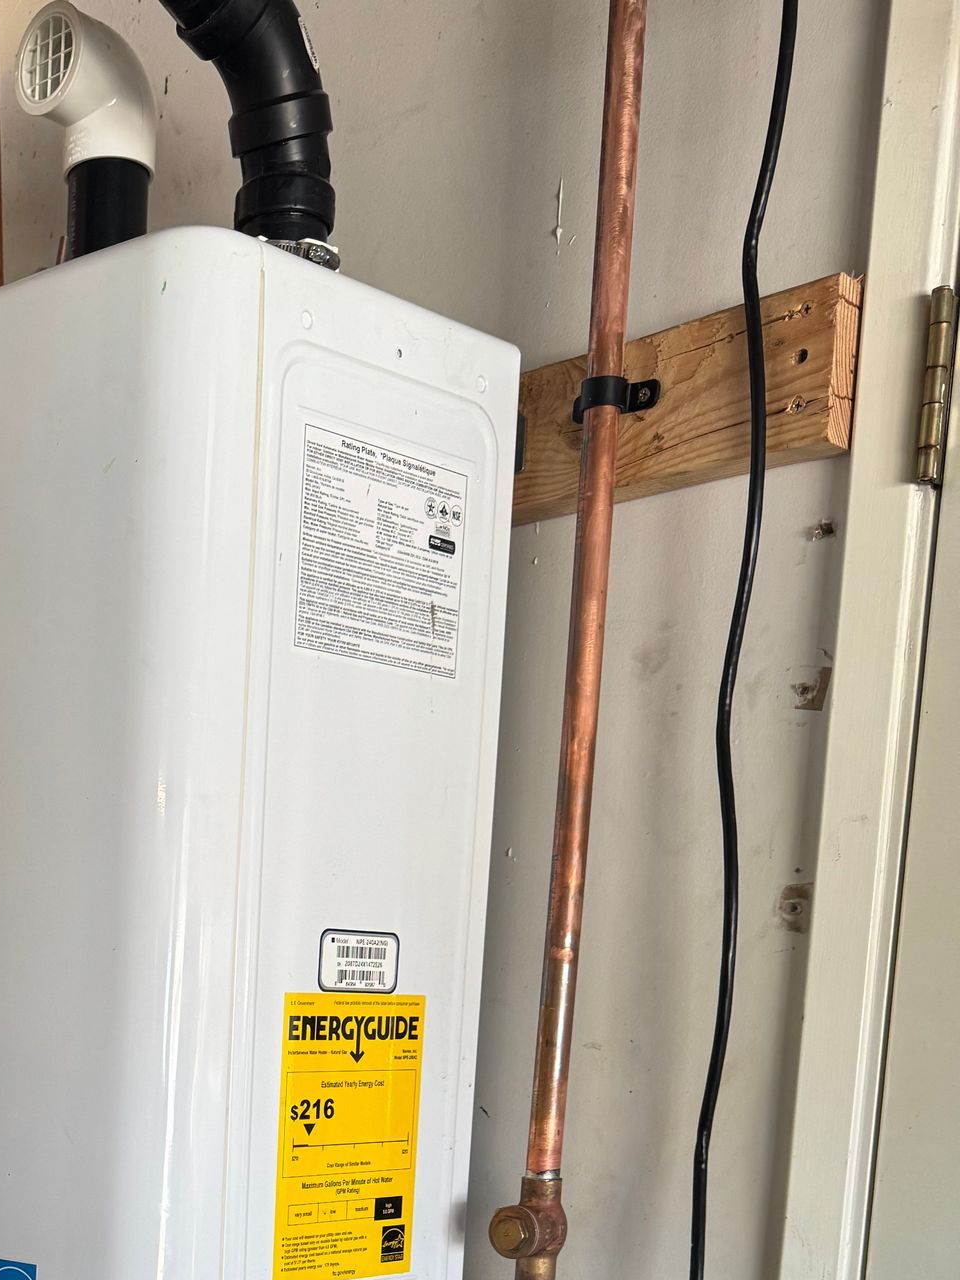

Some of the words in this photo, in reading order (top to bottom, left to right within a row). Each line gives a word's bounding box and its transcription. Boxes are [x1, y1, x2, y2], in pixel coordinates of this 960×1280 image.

[288, 1015, 420, 1042] ENERGYGUIDE
[344, 1080, 358, 1089] Yearly
[358, 1080, 374, 1088] Energy
[374, 1079, 384, 1087] Cost
[290, 1098, 335, 1122] $216
